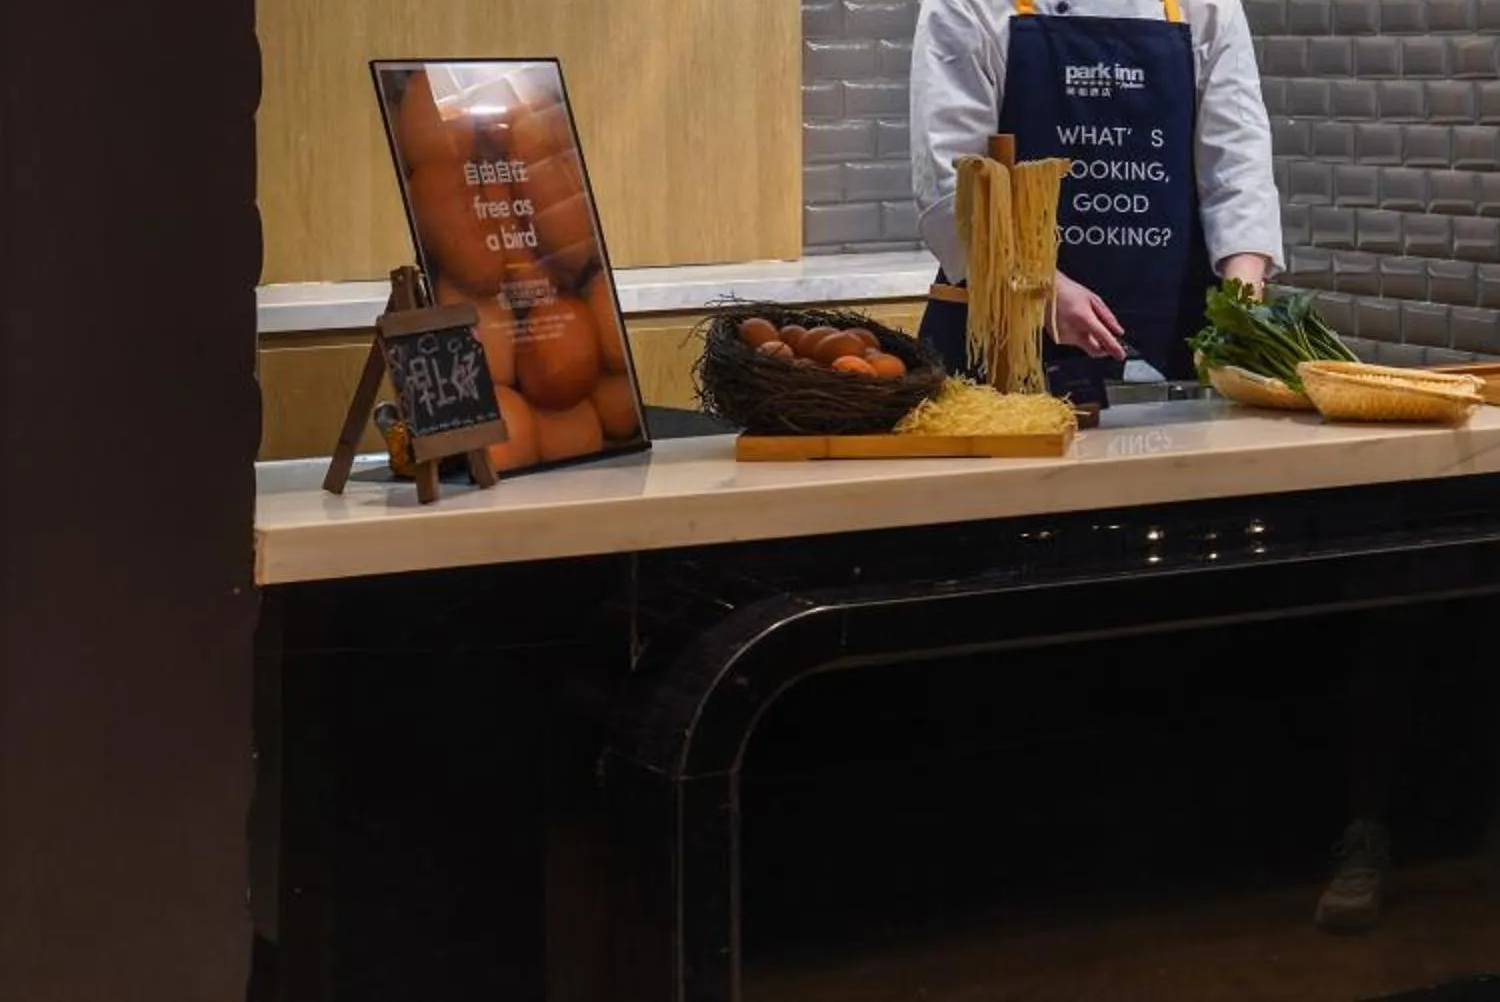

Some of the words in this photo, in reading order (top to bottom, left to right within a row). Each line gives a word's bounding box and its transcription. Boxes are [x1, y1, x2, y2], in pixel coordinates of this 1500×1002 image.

[1065, 61, 1111, 85] park
[1115, 64, 1144, 81] inn
[464, 160, 529, 186] 自由自在
[1061, 159, 1170, 183] OOKING,
[474, 195, 510, 220] free
[513, 199, 534, 216] as
[1073, 193, 1149, 213] GOOD
[486, 234, 500, 251] a
[501, 223, 537, 249] bird
